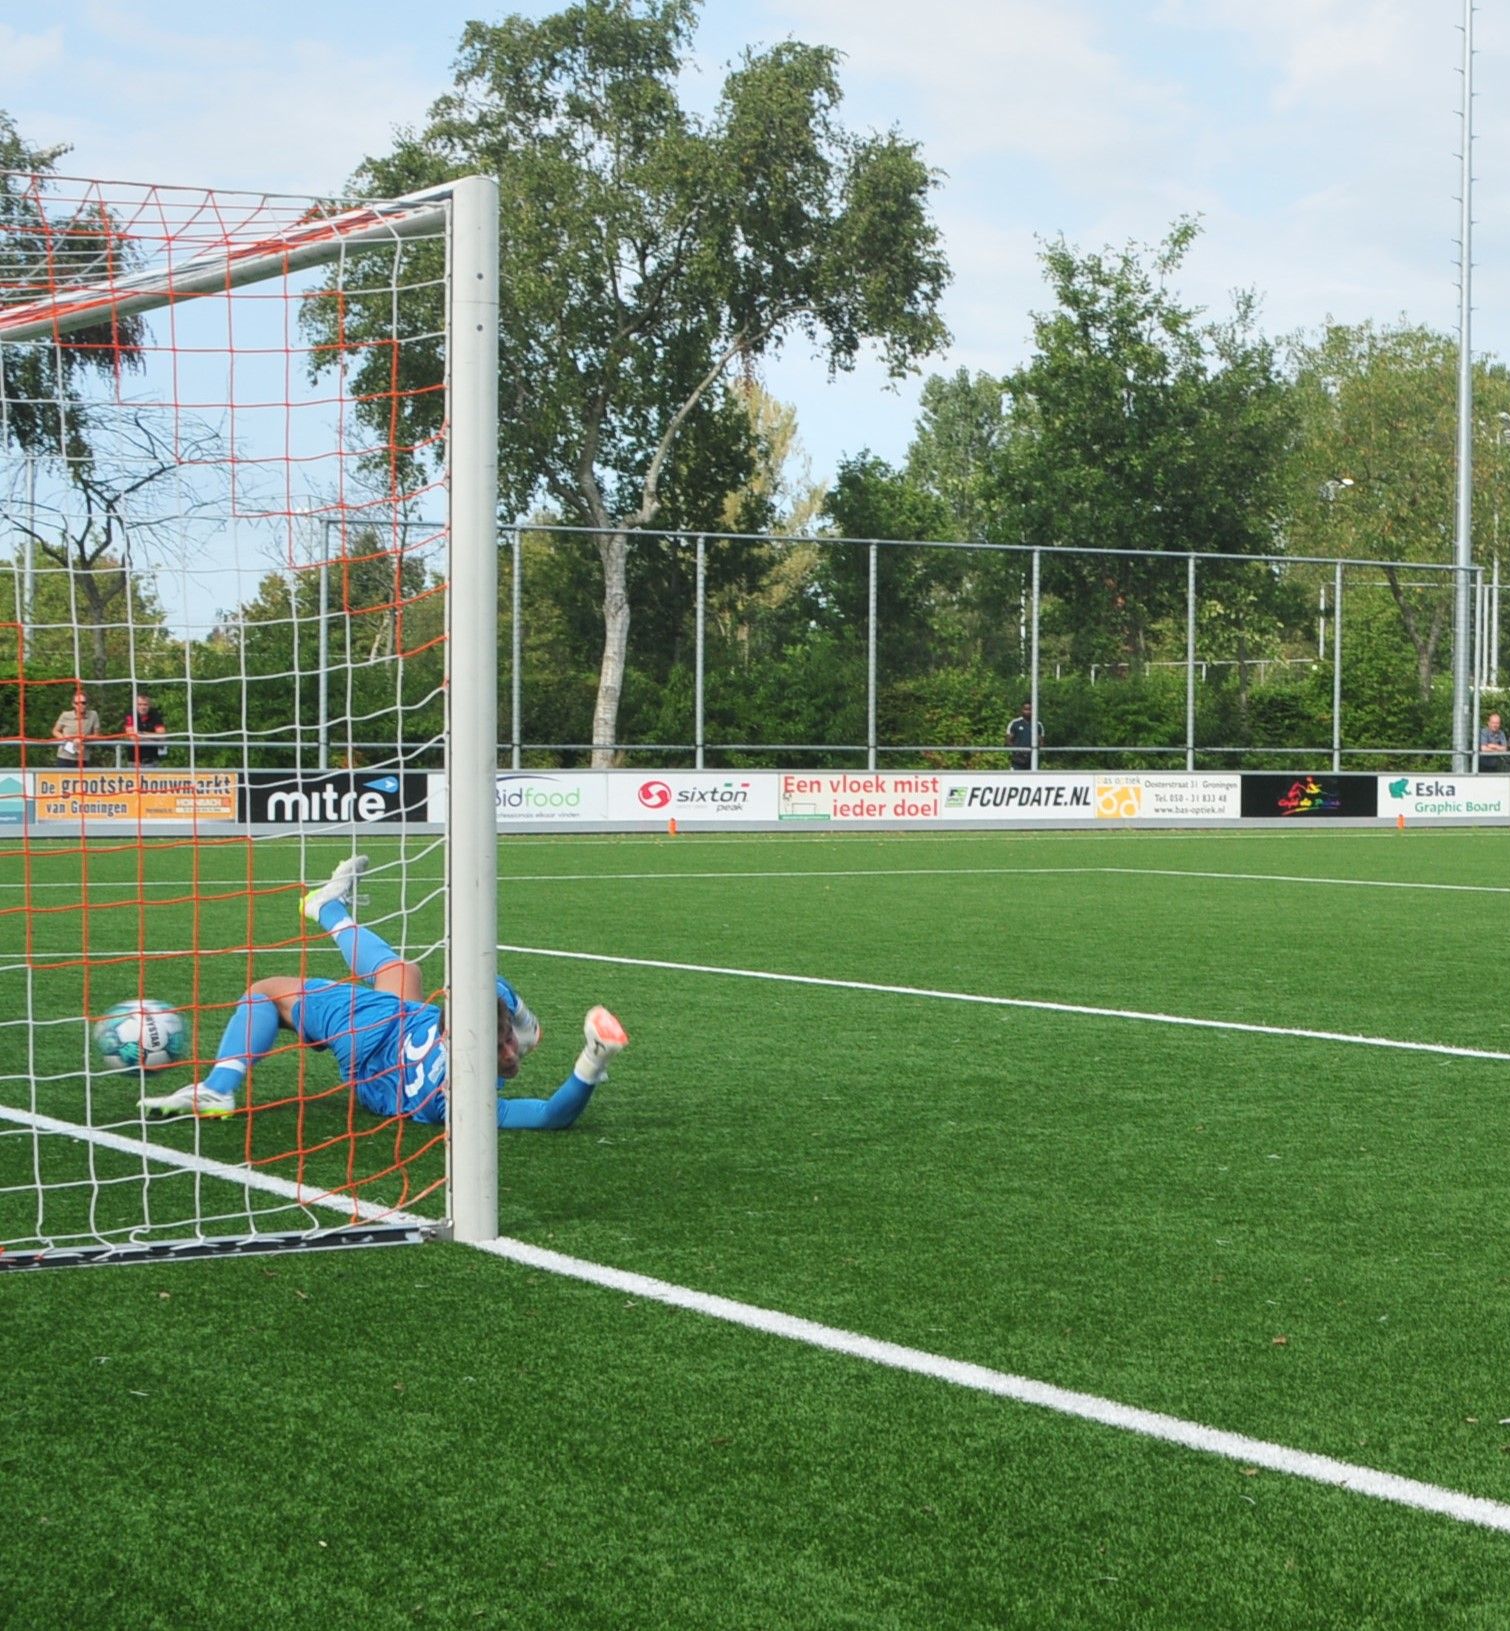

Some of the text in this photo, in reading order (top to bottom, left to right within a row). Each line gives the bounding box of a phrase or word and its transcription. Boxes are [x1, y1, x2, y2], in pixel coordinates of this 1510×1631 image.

[41, 775, 231, 799] De grootste bouwmarkt
[783, 774, 939, 793] Een vloek mist
[1415, 781, 1456, 797] Eska
[267, 783, 386, 822] mitre
[676, 787, 748, 803] sixton
[967, 786, 1091, 807] FCUPDATE.NL
[46, 800, 127, 816] van Groningen
[833, 798, 938, 817] ieder doel
[1414, 801, 1501, 814] Graphic Board
